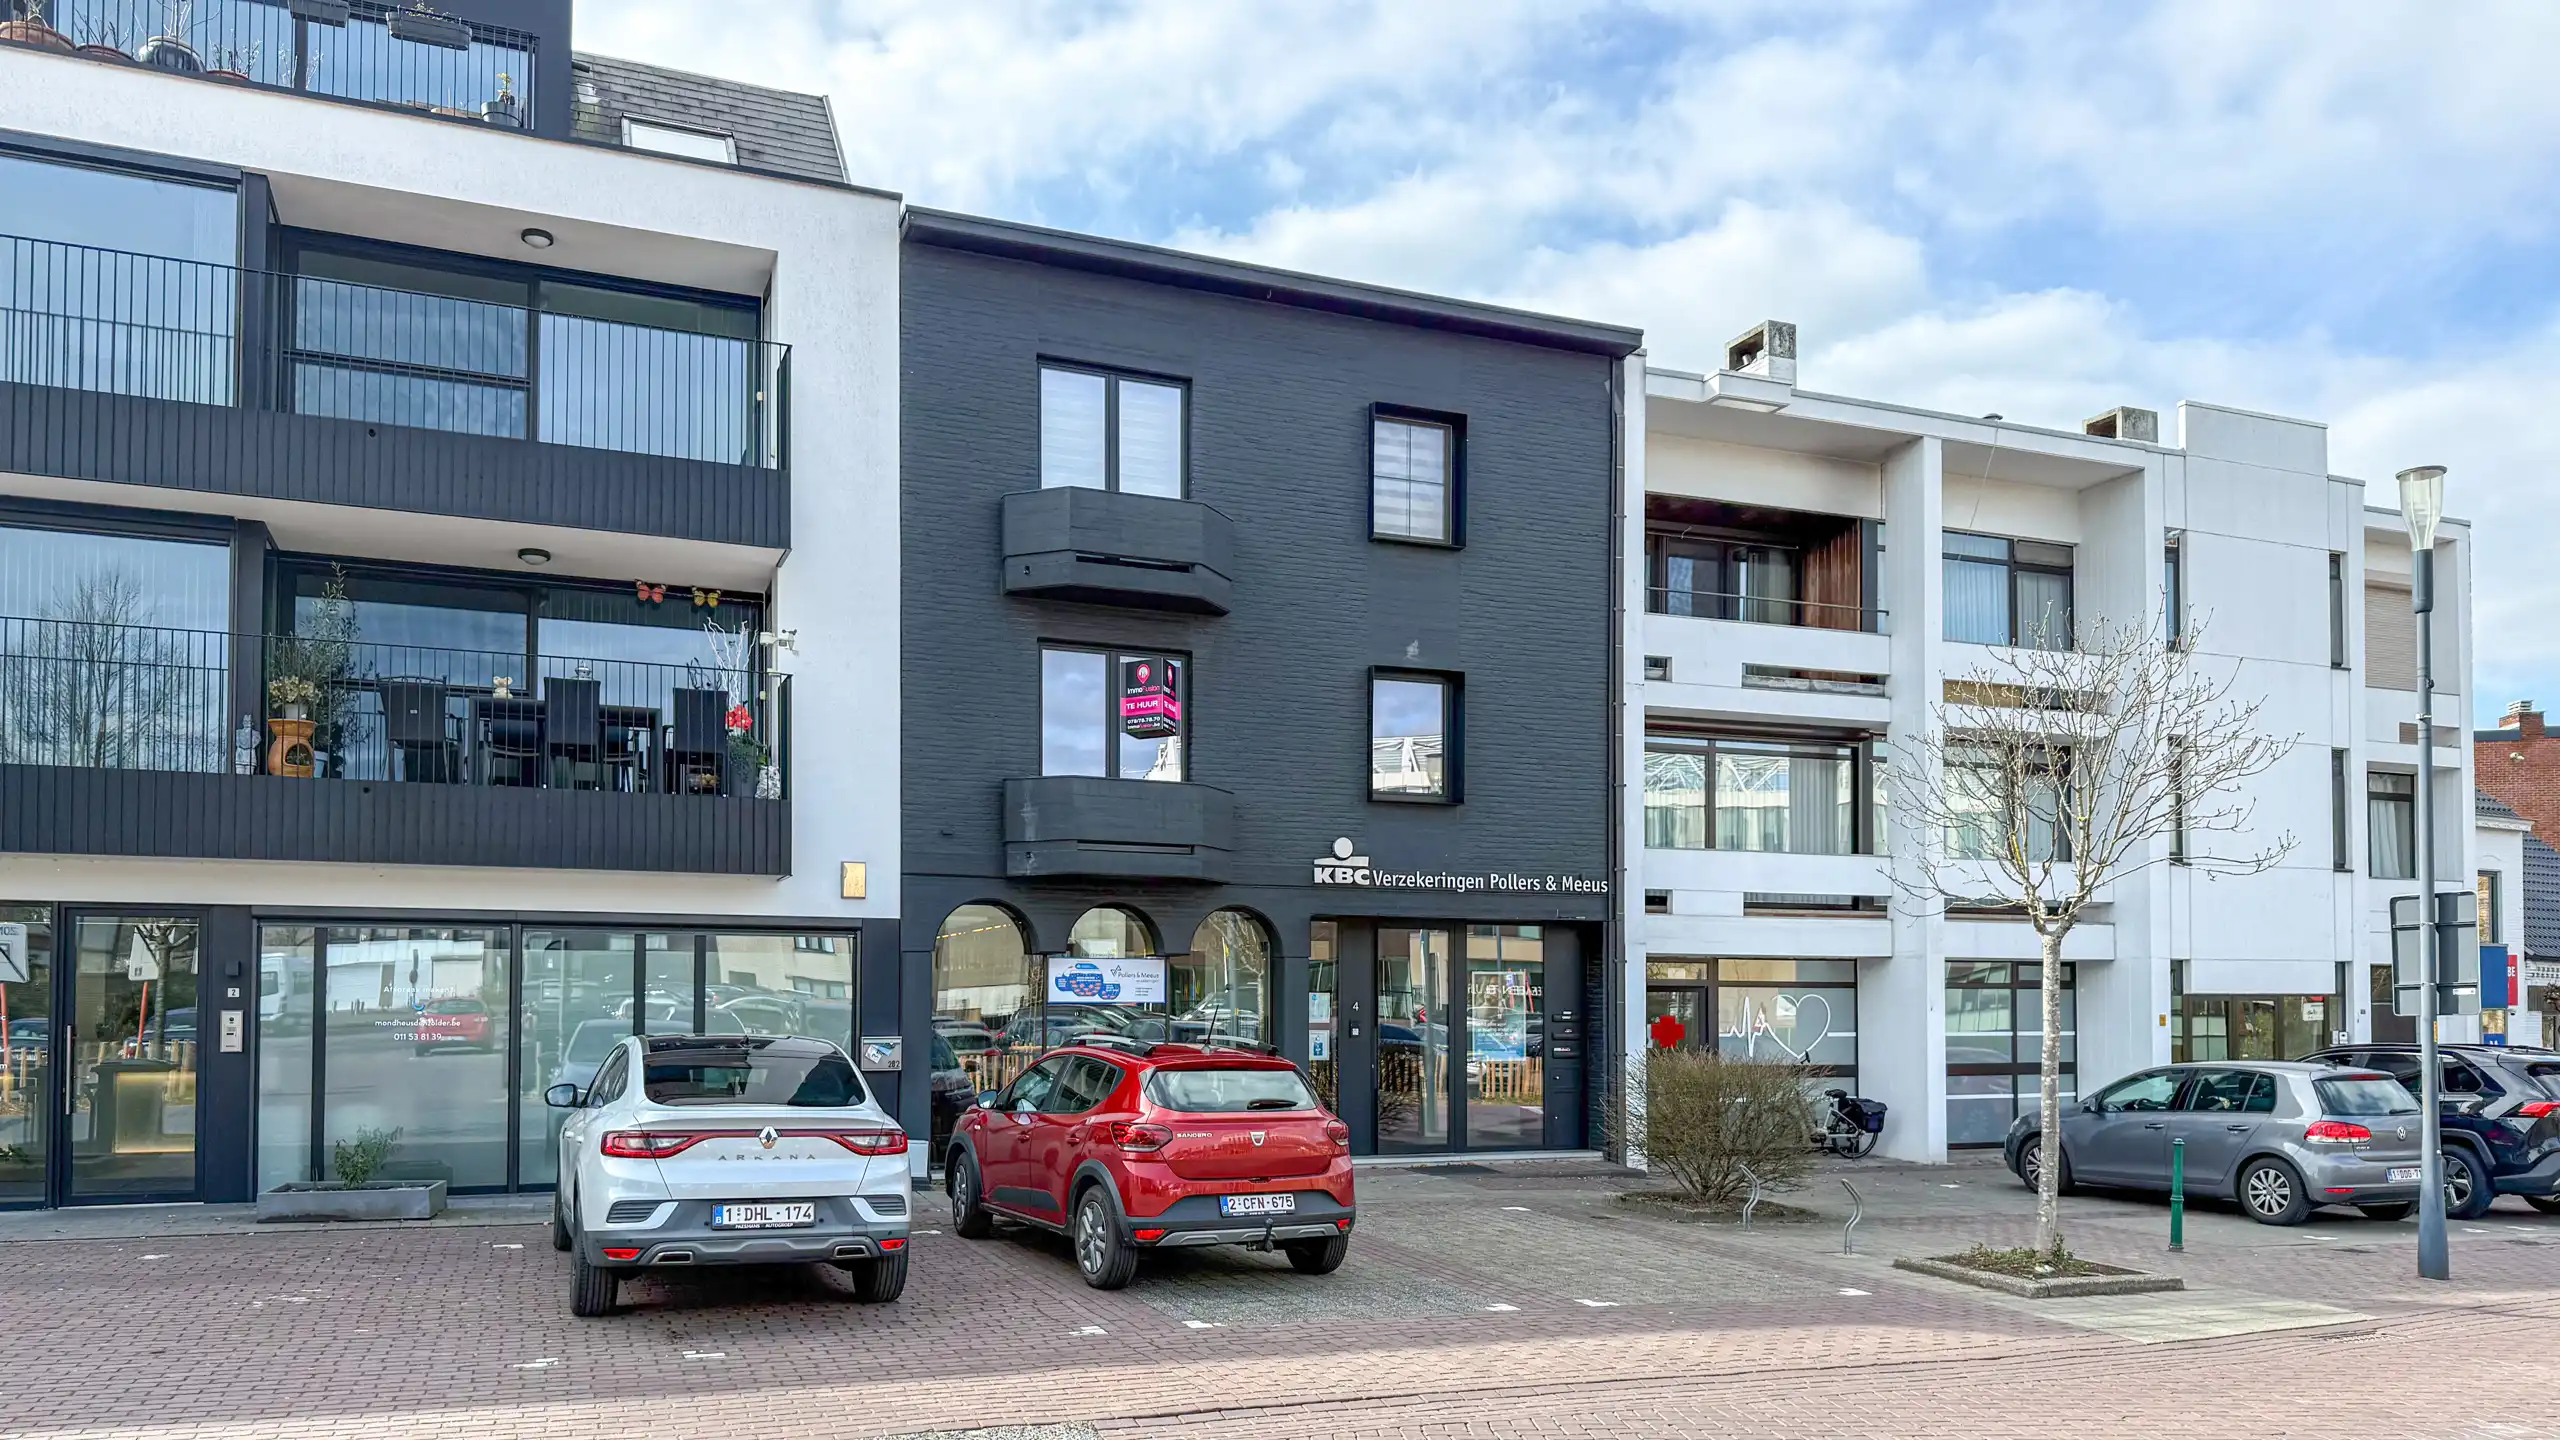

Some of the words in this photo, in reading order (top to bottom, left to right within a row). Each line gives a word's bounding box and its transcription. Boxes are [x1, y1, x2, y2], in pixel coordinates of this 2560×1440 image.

[1126, 702, 1136, 710] TE
[1136, 700, 1159, 709] HUUR
[1314, 867, 1370, 886] KBC
[1372, 869, 1484, 893] Verzekeringen
[1490, 873, 1540, 891] Pollers
[1545, 875, 1557, 891] &
[1562, 875, 1608, 893] Meeus
[231, 988, 237, 996] 2
[1352, 1001, 1360, 1011] 4
[393, 1033, 407, 1041] 011
[408, 1033, 419, 1041] 53
[420, 1033, 430, 1041] 81
[431, 1033, 442, 1041] 39
[715, 1216, 722, 1224] B
